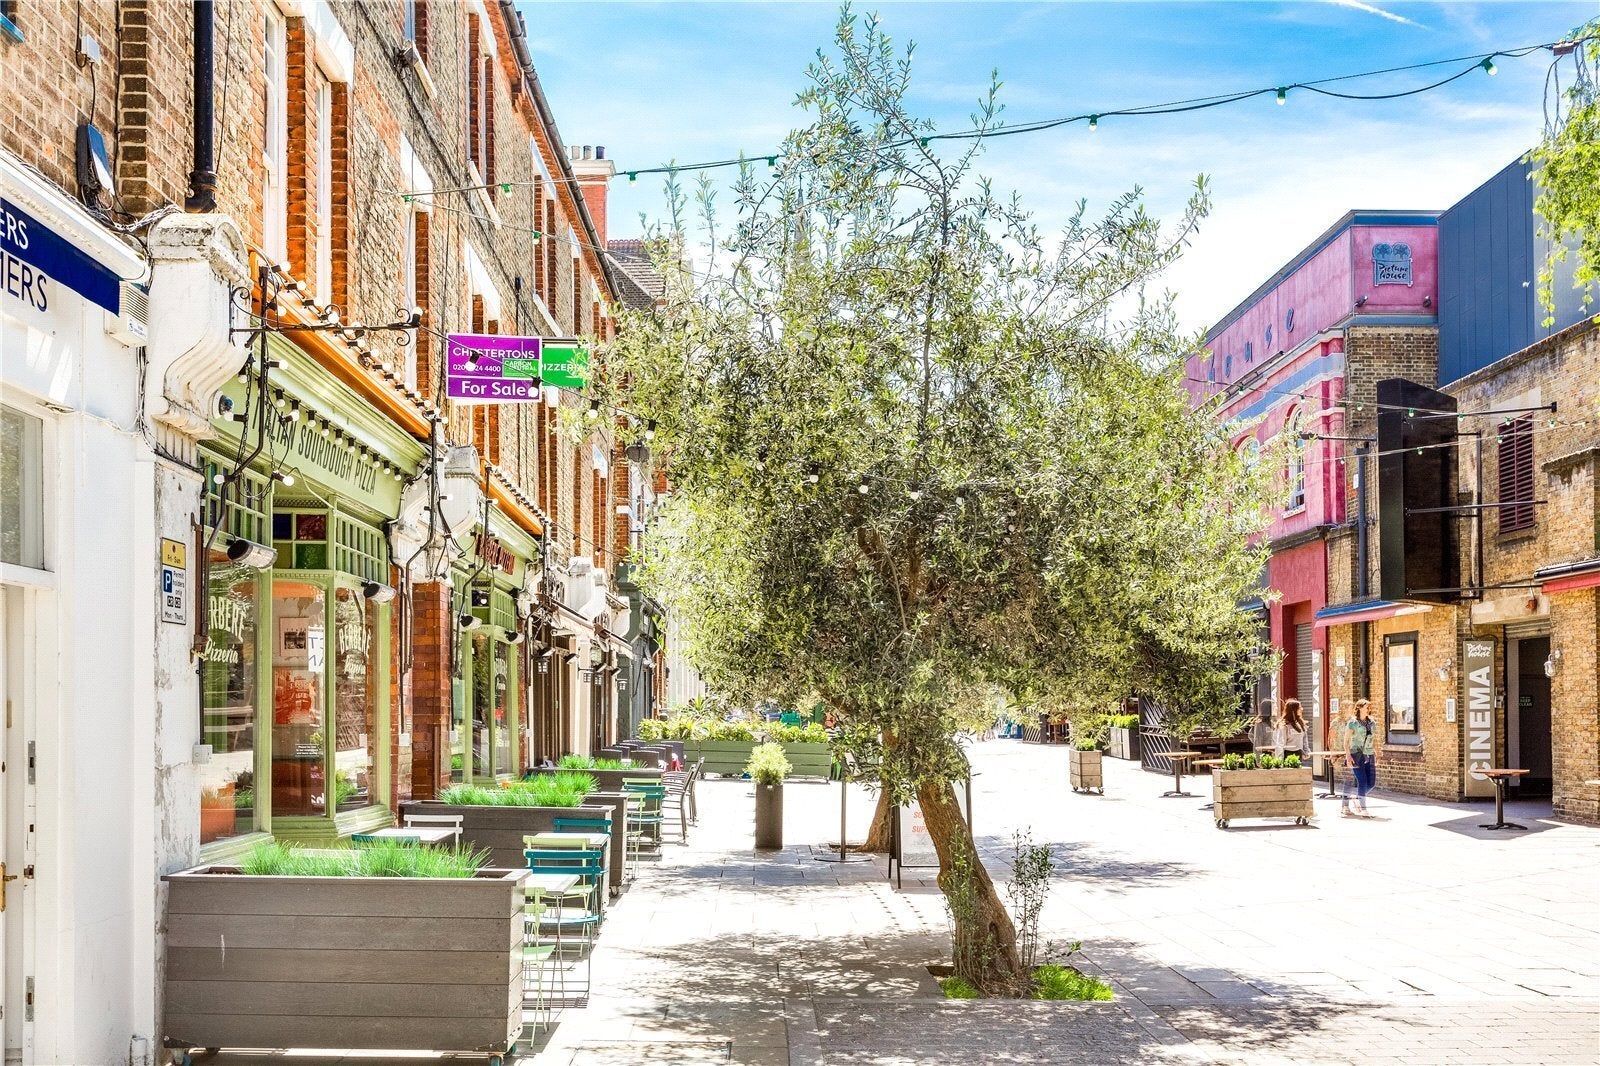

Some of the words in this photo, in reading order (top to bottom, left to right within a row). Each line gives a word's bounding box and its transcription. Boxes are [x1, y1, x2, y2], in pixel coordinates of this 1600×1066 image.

[1377, 262, 1409, 273] Picture
[1379, 270, 1407, 280] house
[461, 380, 487, 395] For
[491, 381, 526, 397] Sale
[252, 396, 298, 450] IALIAN
[298, 424, 354, 483] SOURDOUGH
[353, 458, 378, 496] PIZZA
[202, 636, 239, 664] Pizzeria
[1466, 643, 1492, 652] Picture
[1468, 649, 1490, 658] house
[1312, 669, 1320, 718] BAR
[1468, 665, 1492, 781] CINEMA
